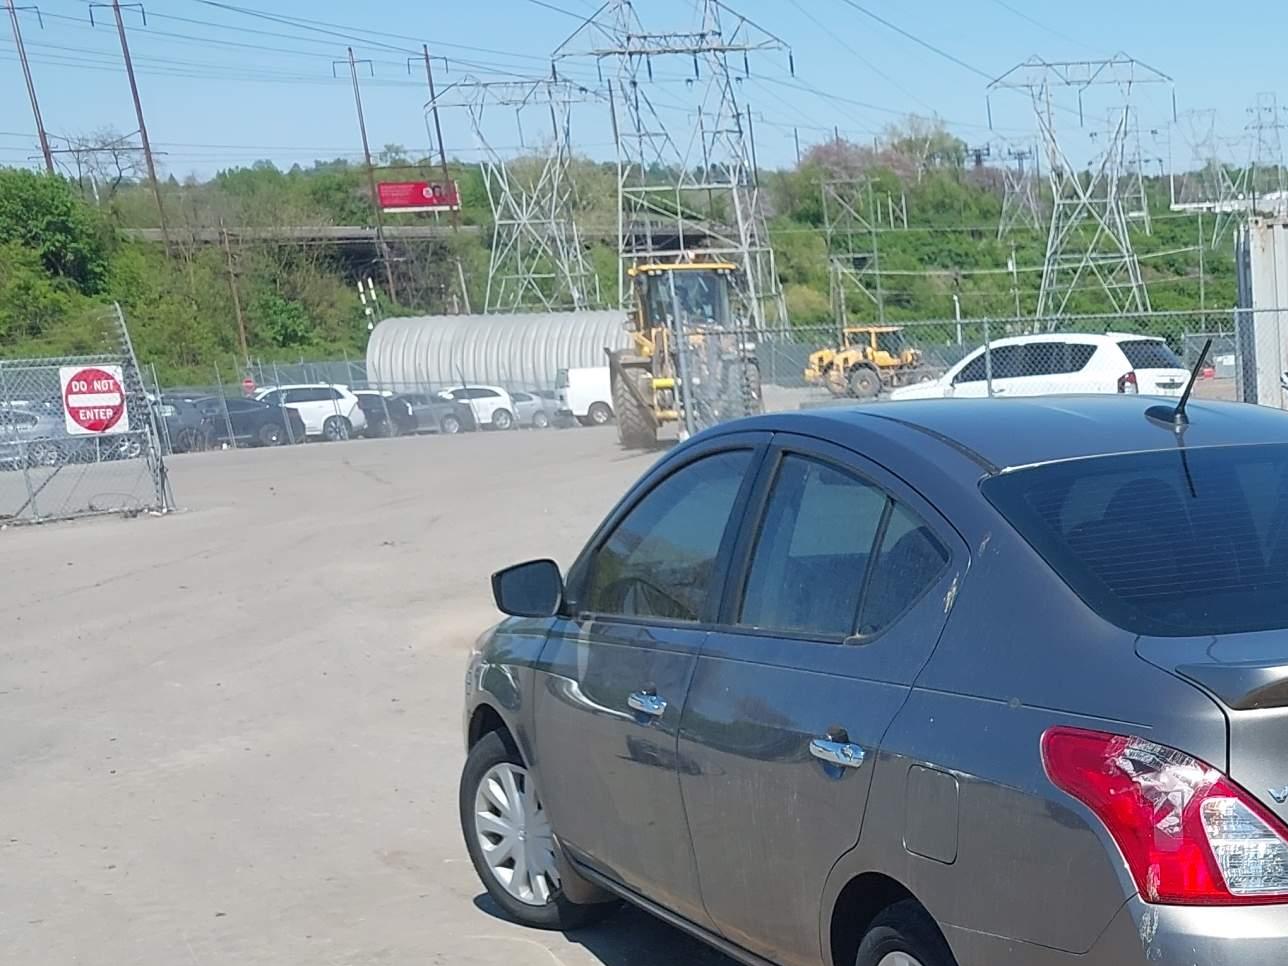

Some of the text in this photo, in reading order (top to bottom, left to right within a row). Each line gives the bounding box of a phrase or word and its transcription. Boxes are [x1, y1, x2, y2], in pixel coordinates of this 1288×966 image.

[71, 379, 114, 392] DO NOT
[79, 408, 113, 420] ENTER
